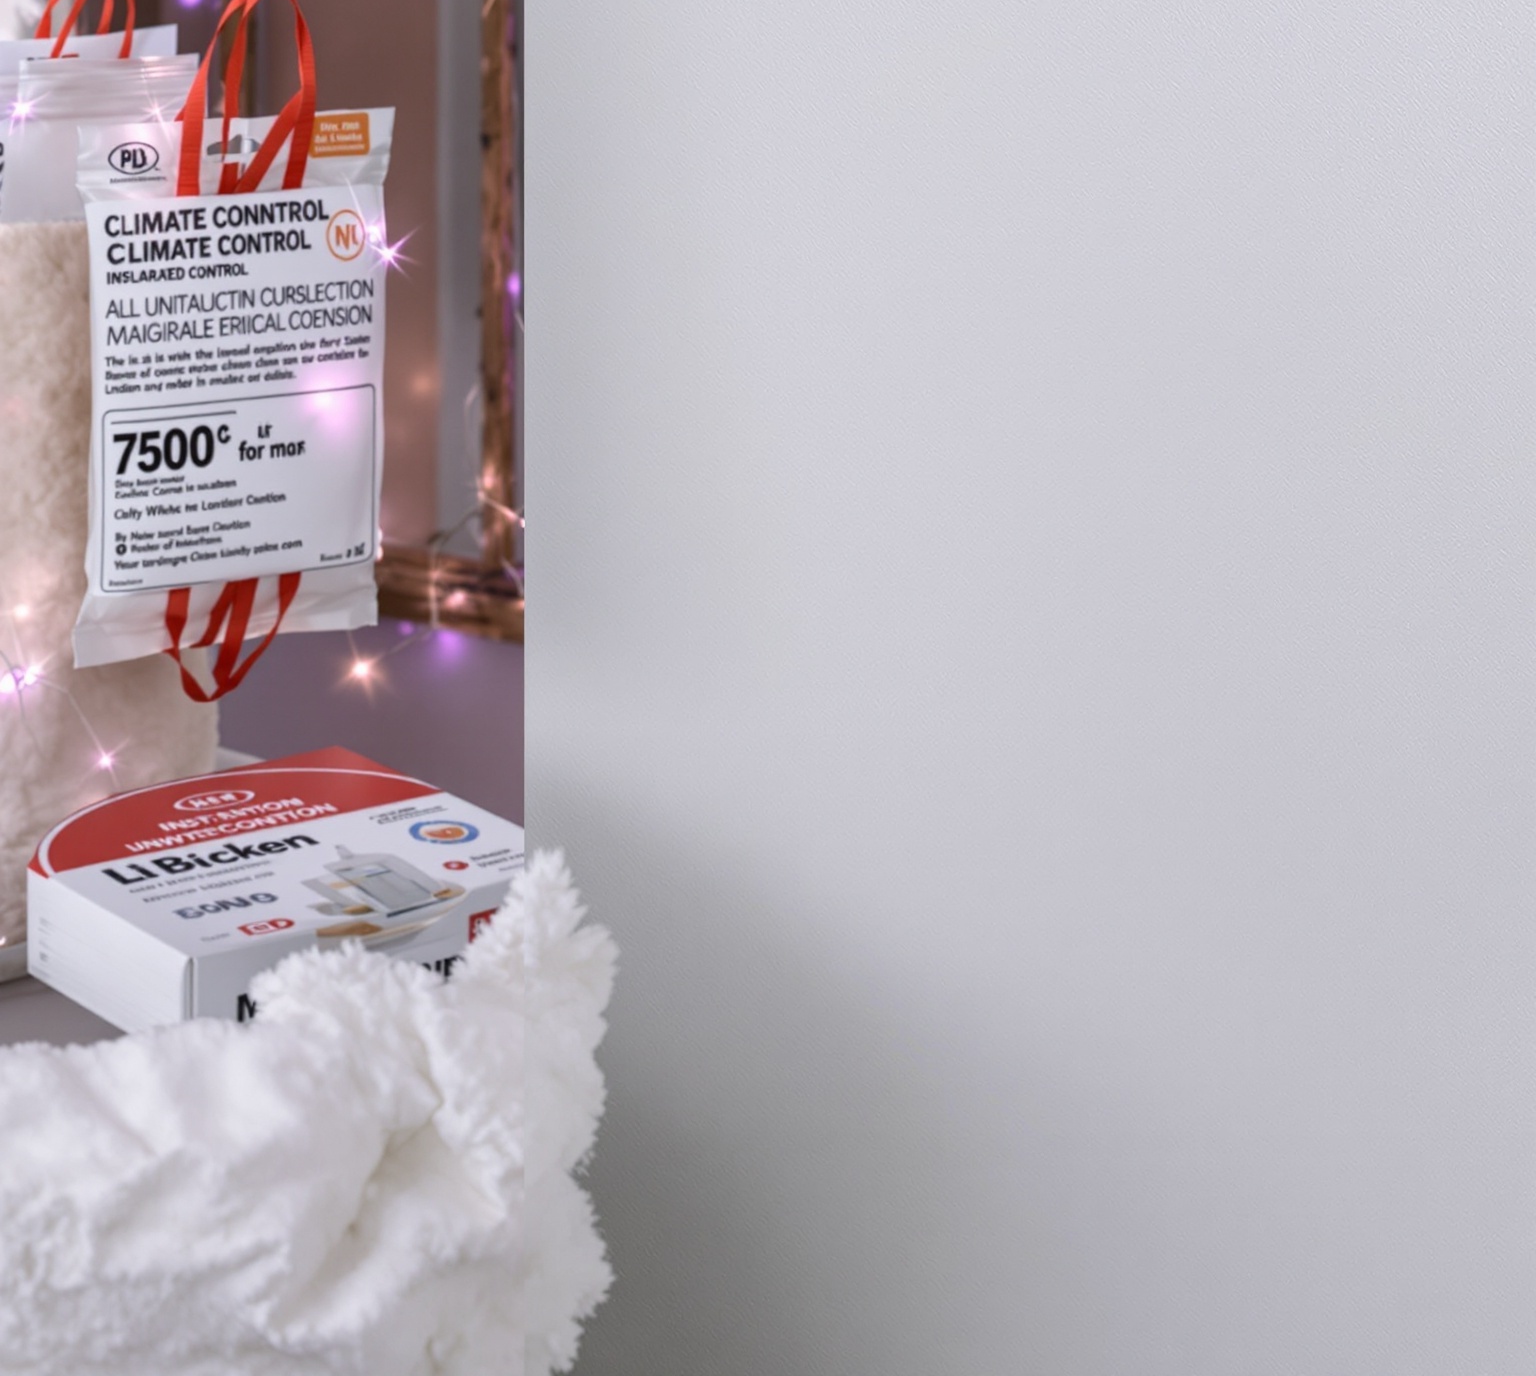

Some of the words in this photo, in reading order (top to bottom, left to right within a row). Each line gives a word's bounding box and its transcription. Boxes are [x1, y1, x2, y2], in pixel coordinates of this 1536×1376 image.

[105, 208, 207, 237] CLIMATE
[212, 199, 330, 229] CONNTROL
[107, 237, 212, 265] CLIMATE
[217, 229, 312, 256] CONTROL
[188, 262, 249, 280] CONTROL
[105, 298, 141, 319] ALL
[260, 278, 375, 308] CURSLECTION
[288, 305, 373, 330] COENSION
[239, 440, 265, 462] for
[151, 834, 321, 875] Bicken
